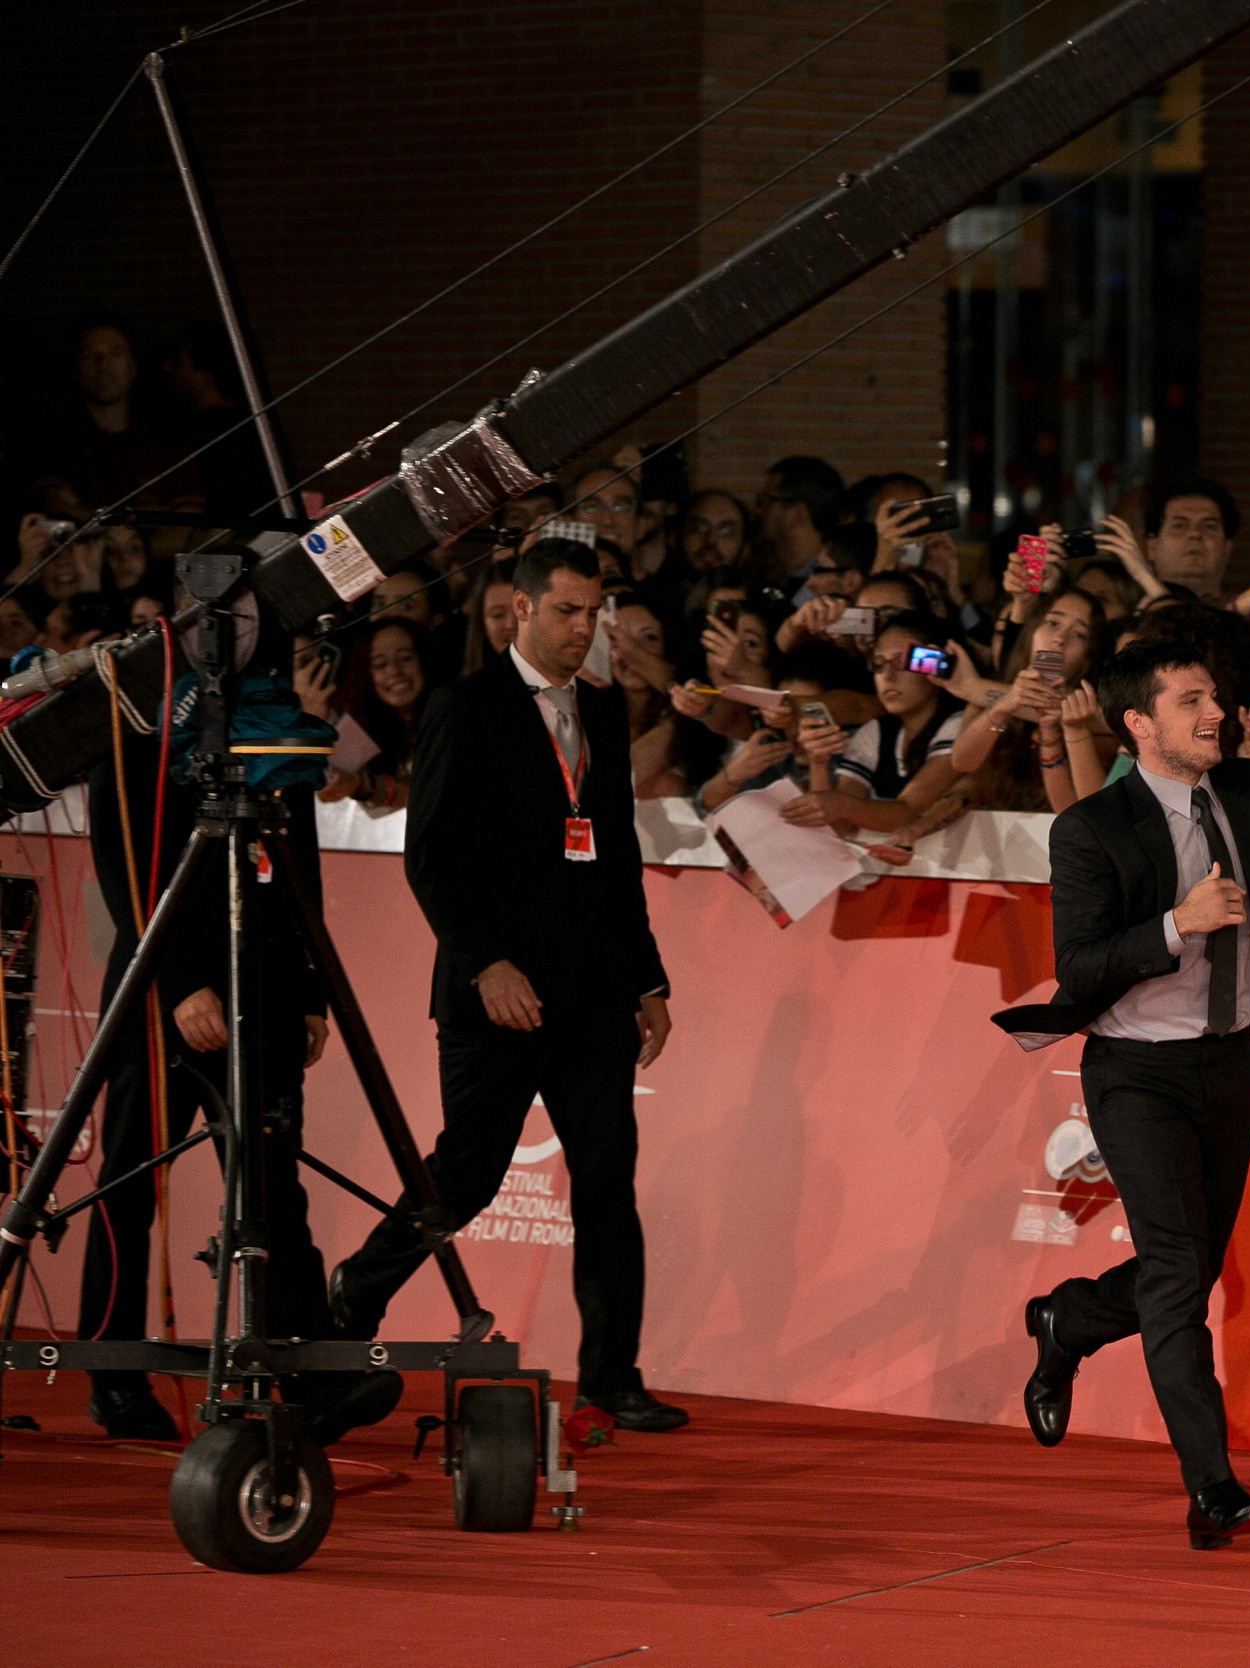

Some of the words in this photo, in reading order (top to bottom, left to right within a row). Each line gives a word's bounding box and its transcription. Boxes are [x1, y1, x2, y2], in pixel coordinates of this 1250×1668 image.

[499, 1169, 555, 1197] STIVAL
[481, 1194, 573, 1223] NAZIONAL
[509, 1220, 530, 1243] DI
[39, 1346, 59, 1366] 9
[369, 1346, 389, 1366] 9
